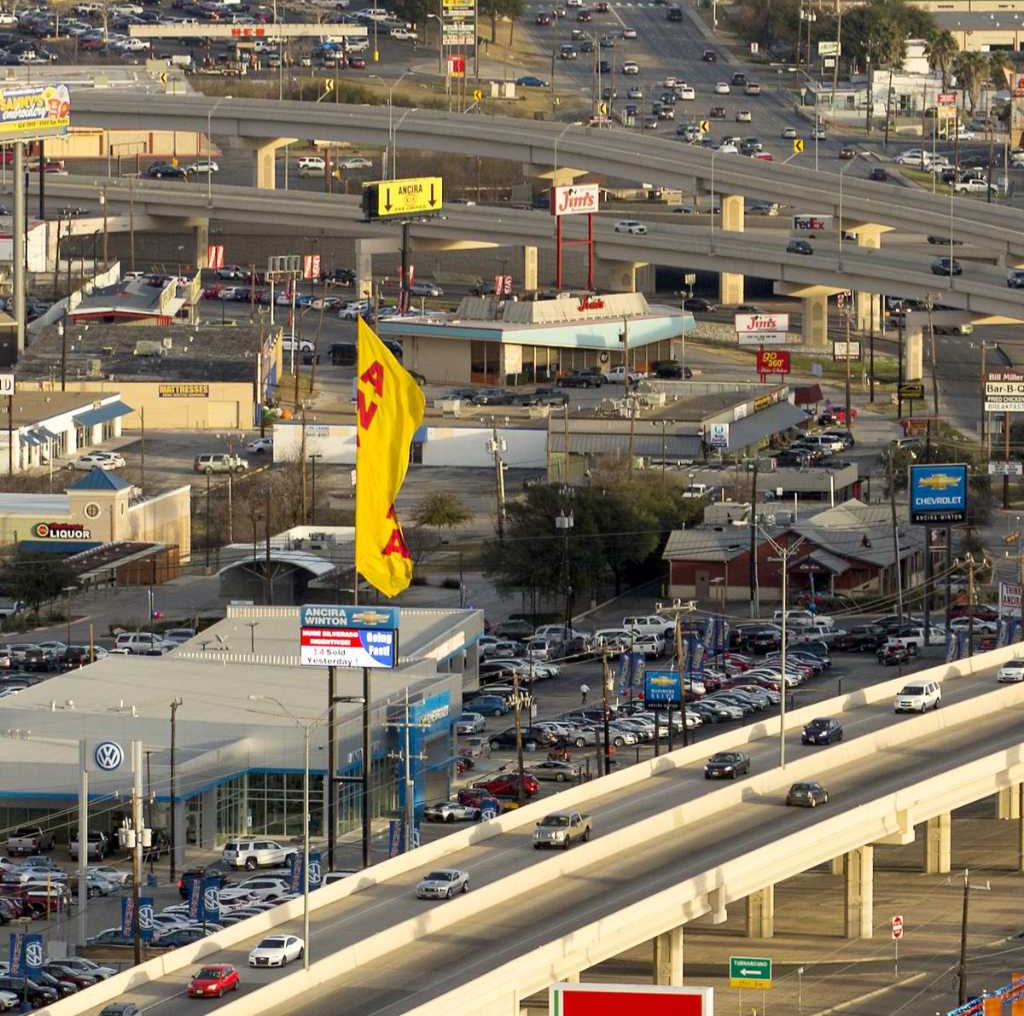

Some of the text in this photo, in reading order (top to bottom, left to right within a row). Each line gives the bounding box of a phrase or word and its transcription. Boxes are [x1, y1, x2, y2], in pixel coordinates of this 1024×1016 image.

[398, 184, 423, 195] ANCIRA
[559, 190, 594, 212] Jim's
[794, 216, 824, 231] FedEx
[747, 316, 777, 330] Jim's
[989, 373, 1024, 381] Bill Miller
[915, 495, 962, 506] CHEVROLET
[50, 529, 91, 539] LIQUOR
[305, 608, 346, 617] ANCIRA
[304, 616, 348, 626] WINTON
[366, 631, 393, 645] Going
[327, 648, 346, 656] Sold
[308, 657, 353, 667] Yesterday
[734, 960, 768, 968] TURNAROUND
